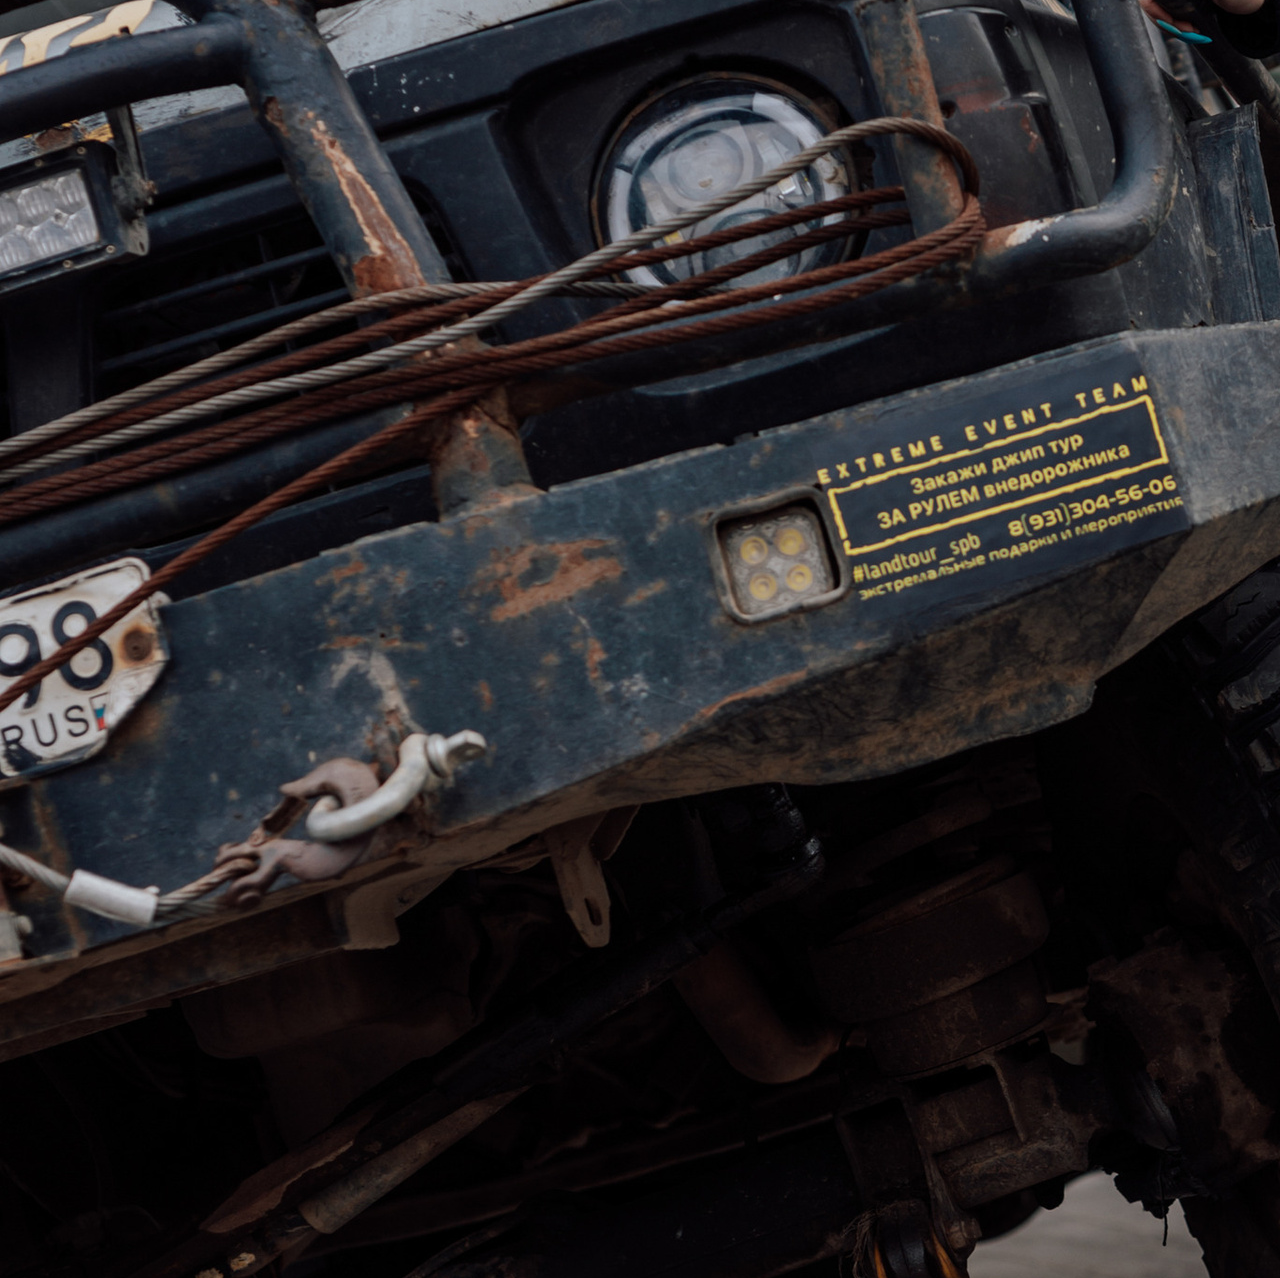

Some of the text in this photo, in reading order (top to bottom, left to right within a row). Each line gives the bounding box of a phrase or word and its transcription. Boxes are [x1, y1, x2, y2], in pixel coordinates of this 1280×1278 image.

[816, 375, 1148, 485] EXTREME EVENT TEAM
[910, 433, 1084, 495] Закажи джип тур
[853, 475, 1177, 583] #landtour_spb 8(931)304-56-06
[877, 444, 1131, 529] ЗА РУЛЕМ внедорожника
[858, 496, 1184, 600] экстремальные подарки и мероприятия
[1, 704, 90, 751] RUS
